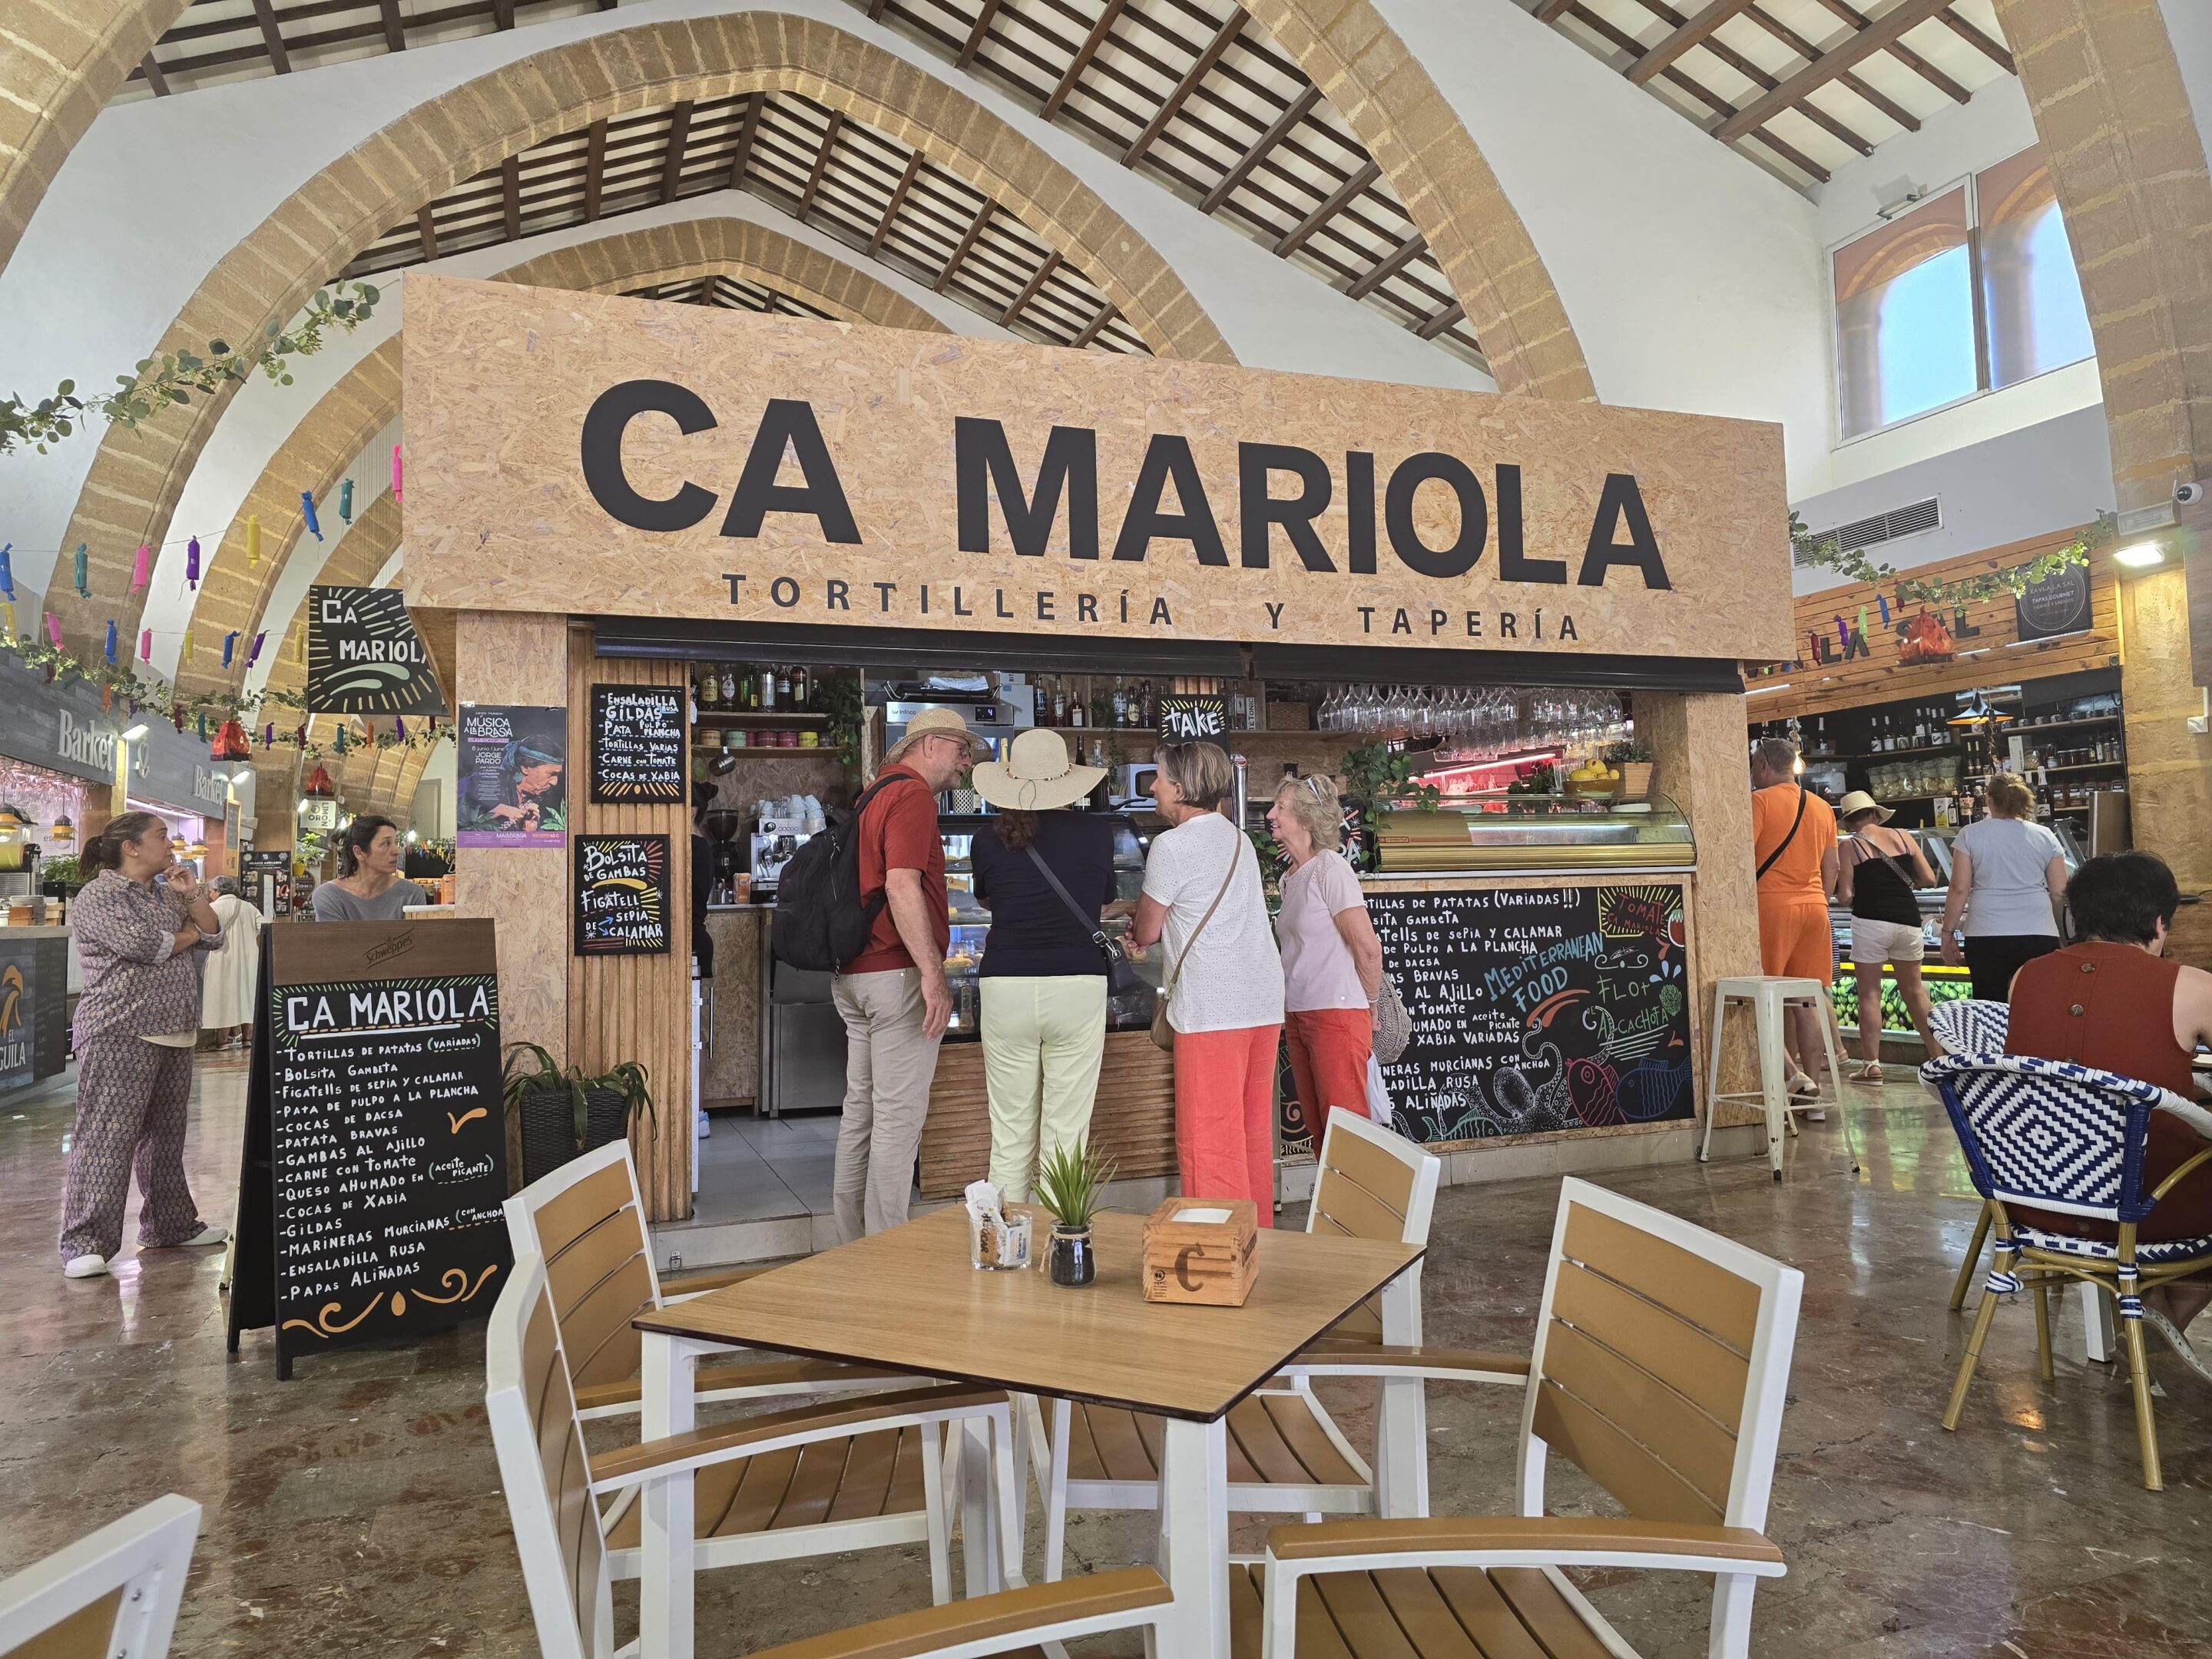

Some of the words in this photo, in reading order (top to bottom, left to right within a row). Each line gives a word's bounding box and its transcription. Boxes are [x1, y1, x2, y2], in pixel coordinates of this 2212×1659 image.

[581, 379, 863, 545] CA
[955, 416, 1671, 591] MARIOLA
[2048, 590, 2075, 600] GOURMET
[323, 600, 357, 623] CA
[722, 574, 1173, 625] TORTILLERÍA
[1265, 603, 1284, 629] Y
[1357, 606, 1578, 641] TAPERÍA
[1820, 630, 1869, 664] LA
[467, 715, 510, 728] MÚSICA
[1164, 707, 1220, 737] TAKE
[58, 709, 113, 772] Barket
[478, 727, 513, 737] BRASA
[602, 753, 632, 764] CARNE
[194, 765, 223, 806] Barket
[584, 873, 594, 881] DE
[597, 866, 646, 879] GAMBAS
[1618, 892, 1666, 926] TOMATE
[586, 922, 597, 930] DE
[610, 923, 663, 939] CALAMAR
[1489, 929, 1496, 938] Y
[1504, 926, 1562, 939] CALAMAR
[366, 935, 413, 964] Schweppes
[1446, 944, 1453, 953] A
[1461, 942, 1478, 952] LA
[1485, 940, 1538, 955] PLANCHA
[1406, 958, 1440, 967] DACSA
[1414, 969, 1459, 983] BRAVAS
[1415, 986, 1431, 998] AL
[1512, 966, 1568, 1012] FOOD
[287, 996, 335, 1031] CA
[349, 985, 488, 1026] MARIOLA
[1457, 1019, 1467, 1029] EN
[8, 1028, 14, 1042] EL
[362, 1048, 373, 1056] DE
[1501, 1054, 1520, 1064] CON
[1514, 1059, 1550, 1071] ANCHOA
[350, 1084, 360, 1092] DE
[403, 1078, 409, 1087] Y
[415, 1071, 463, 1084] CALAMAR
[1445, 1075, 1479, 1088] RUSA
[283, 1105, 319, 1117] PATA
[327, 1101, 340, 1111] DE
[351, 1095, 385, 1108] PULPO
[393, 1094, 400, 1102] A
[409, 1091, 422, 1101] LA
[430, 1084, 478, 1098] PLANCHA
[286, 1119, 329, 1133] COCAS
[345, 1114, 356, 1124] DE
[366, 1109, 403, 1121] DACSA
[350, 1126, 398, 1141] BRAVAS
[286, 1147, 346, 1166] GAMBAS
[356, 1144, 373, 1156] AL
[285, 1167, 328, 1184] CARNE
[336, 1164, 359, 1176] CON
[286, 1185, 329, 1201] QUESO
[339, 1175, 405, 1193] AHUMADO
[412, 1174, 423, 1183] EN
[286, 1204, 332, 1220] COCAS
[343, 1200, 353, 1210] DE
[389, 1242, 425, 1257] RUSA
[1174, 1242, 1205, 1292] C
[290, 1282, 339, 1300] PAPAS
